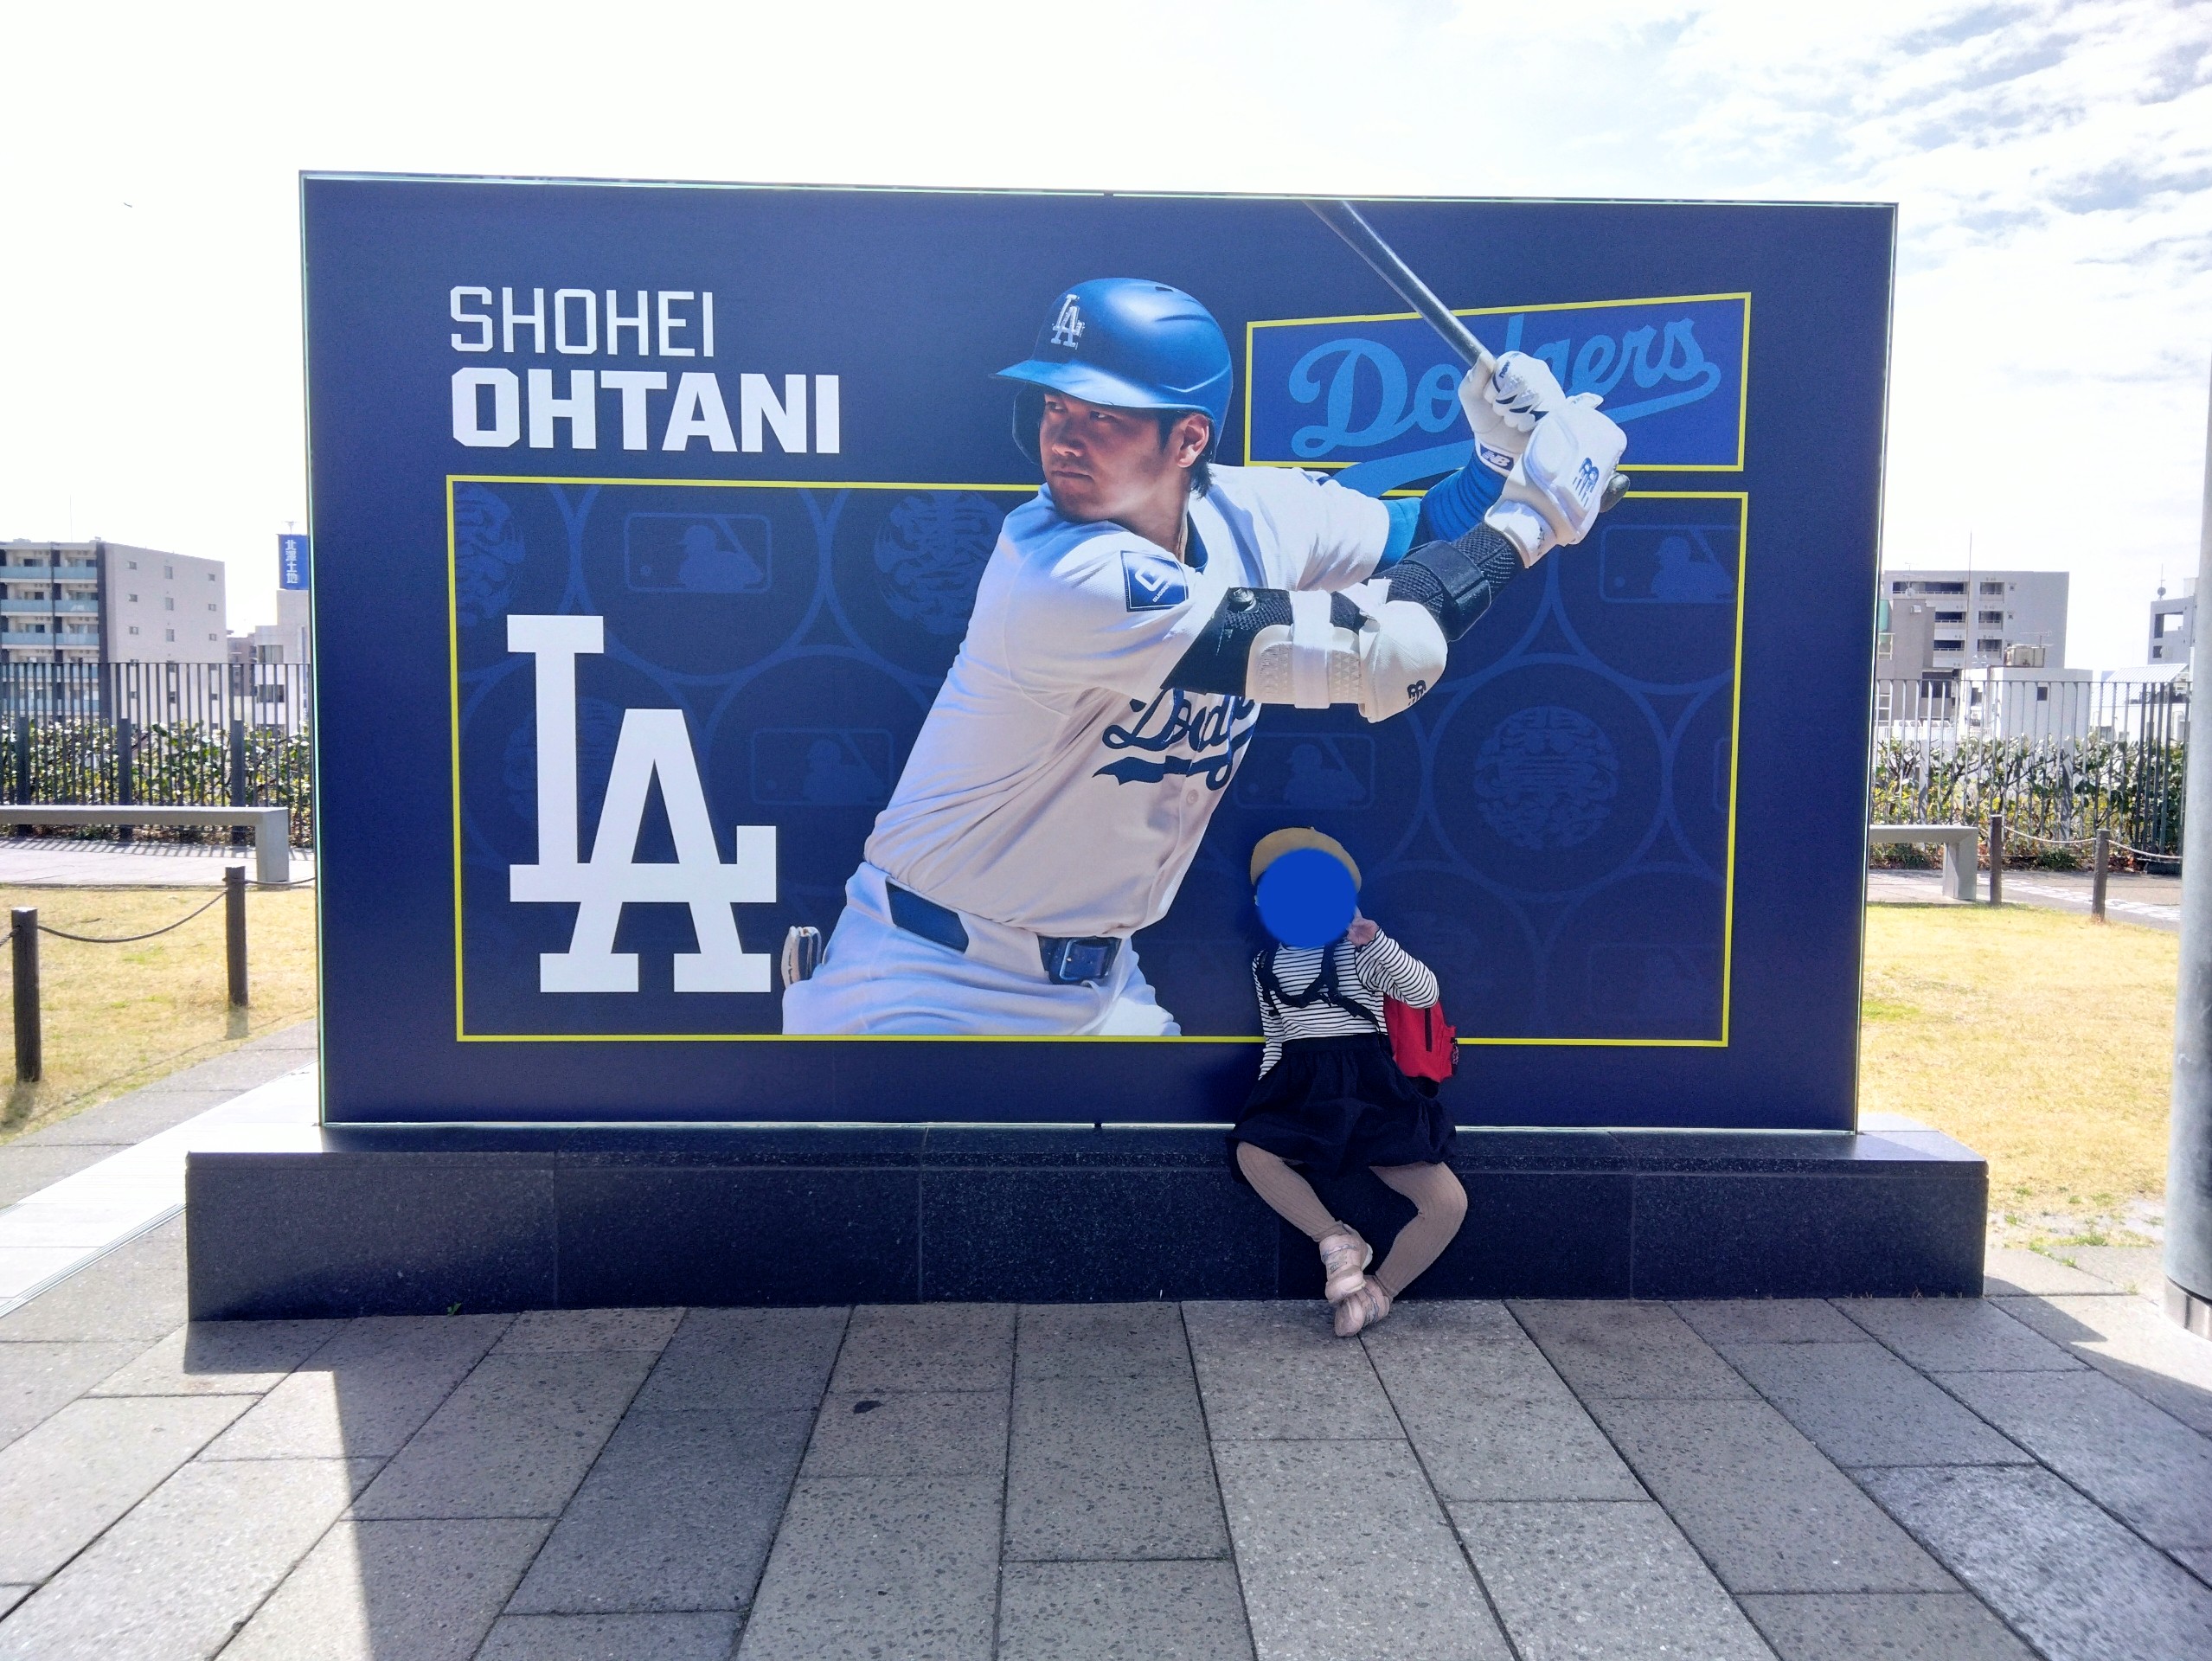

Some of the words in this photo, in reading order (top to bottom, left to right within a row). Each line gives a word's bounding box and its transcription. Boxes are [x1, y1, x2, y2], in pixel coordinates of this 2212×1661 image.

[450, 285, 715, 357] SHOHEI
[1050, 293, 1086, 350] LA
[452, 367, 840, 454] OHTANI
[507, 614, 777, 993] LA
